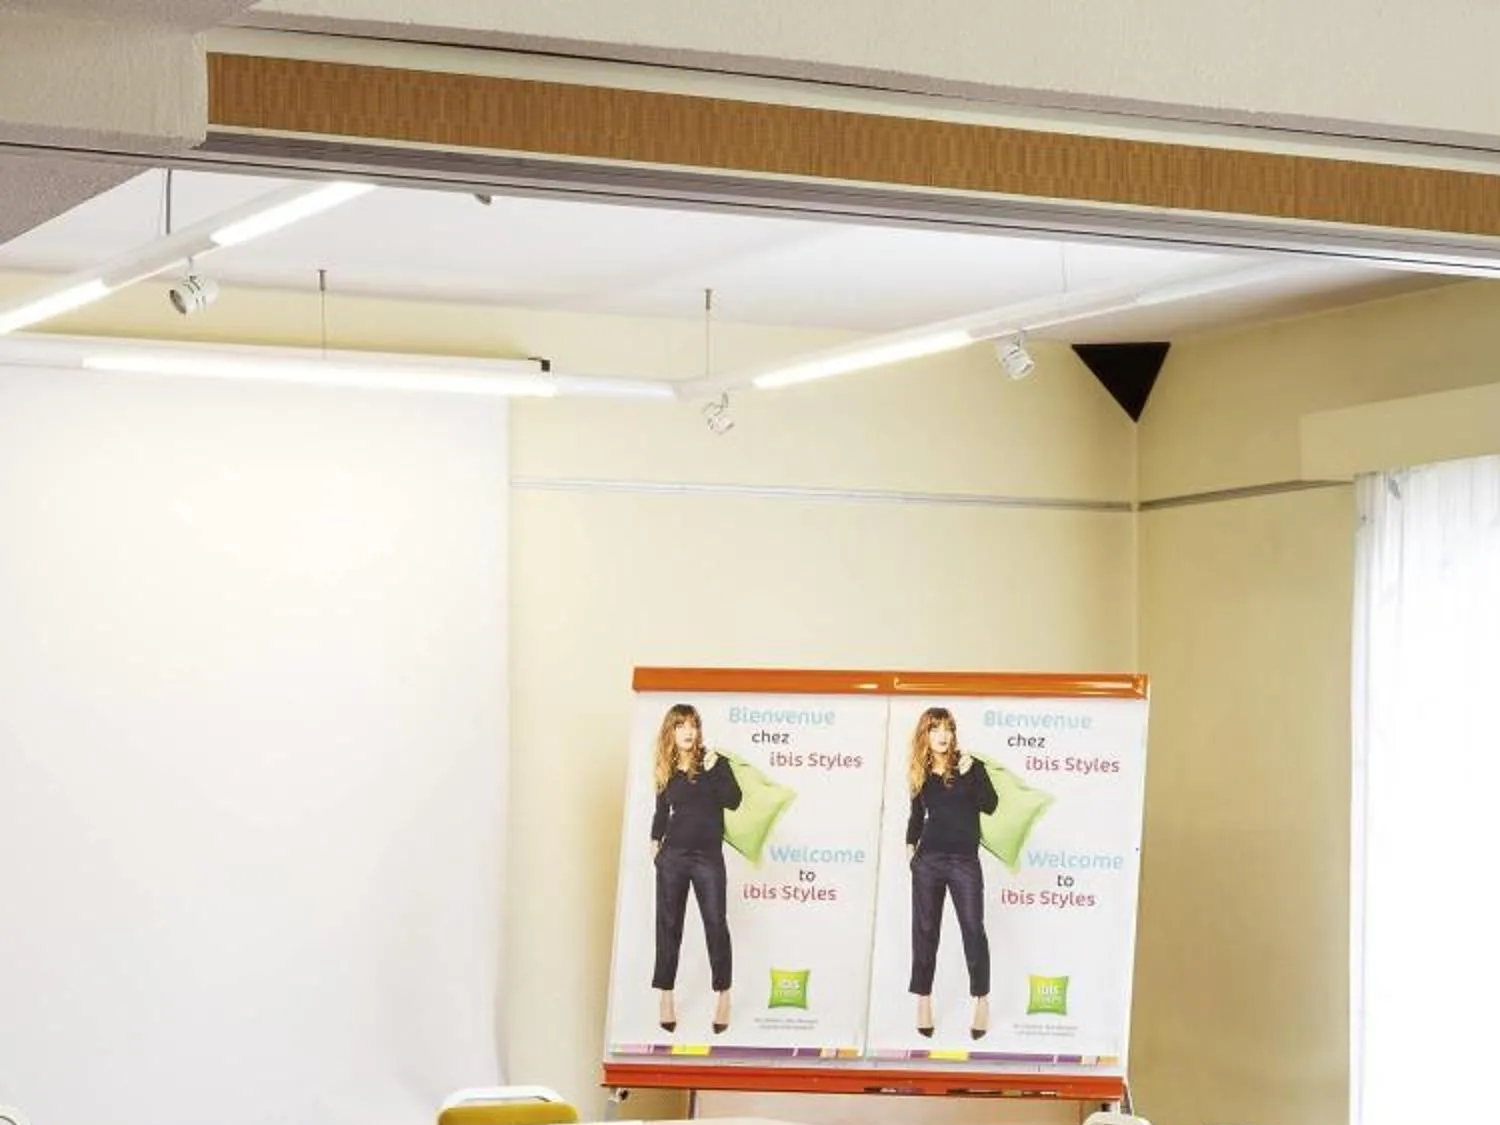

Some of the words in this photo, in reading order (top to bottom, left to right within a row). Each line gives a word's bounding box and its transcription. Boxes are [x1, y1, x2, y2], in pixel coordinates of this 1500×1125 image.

[729, 706, 835, 725] Bienvenue
[984, 710, 1093, 729] Bienvenue
[751, 729, 790, 744] chez
[1007, 733, 1046, 748] chez
[769, 752, 803, 767] ibis
[807, 753, 863, 771] Styles
[1026, 756, 1060, 771] ibis
[1065, 757, 1120, 775] Styles
[769, 845, 865, 863] Welcome
[1028, 849, 1124, 869] Welcome
[799, 869, 816, 882] to
[1057, 875, 1075, 887] to
[743, 884, 777, 899] ibis
[781, 885, 837, 902] Styles
[1001, 888, 1035, 904] ibis
[1040, 890, 1096, 908] Styles
